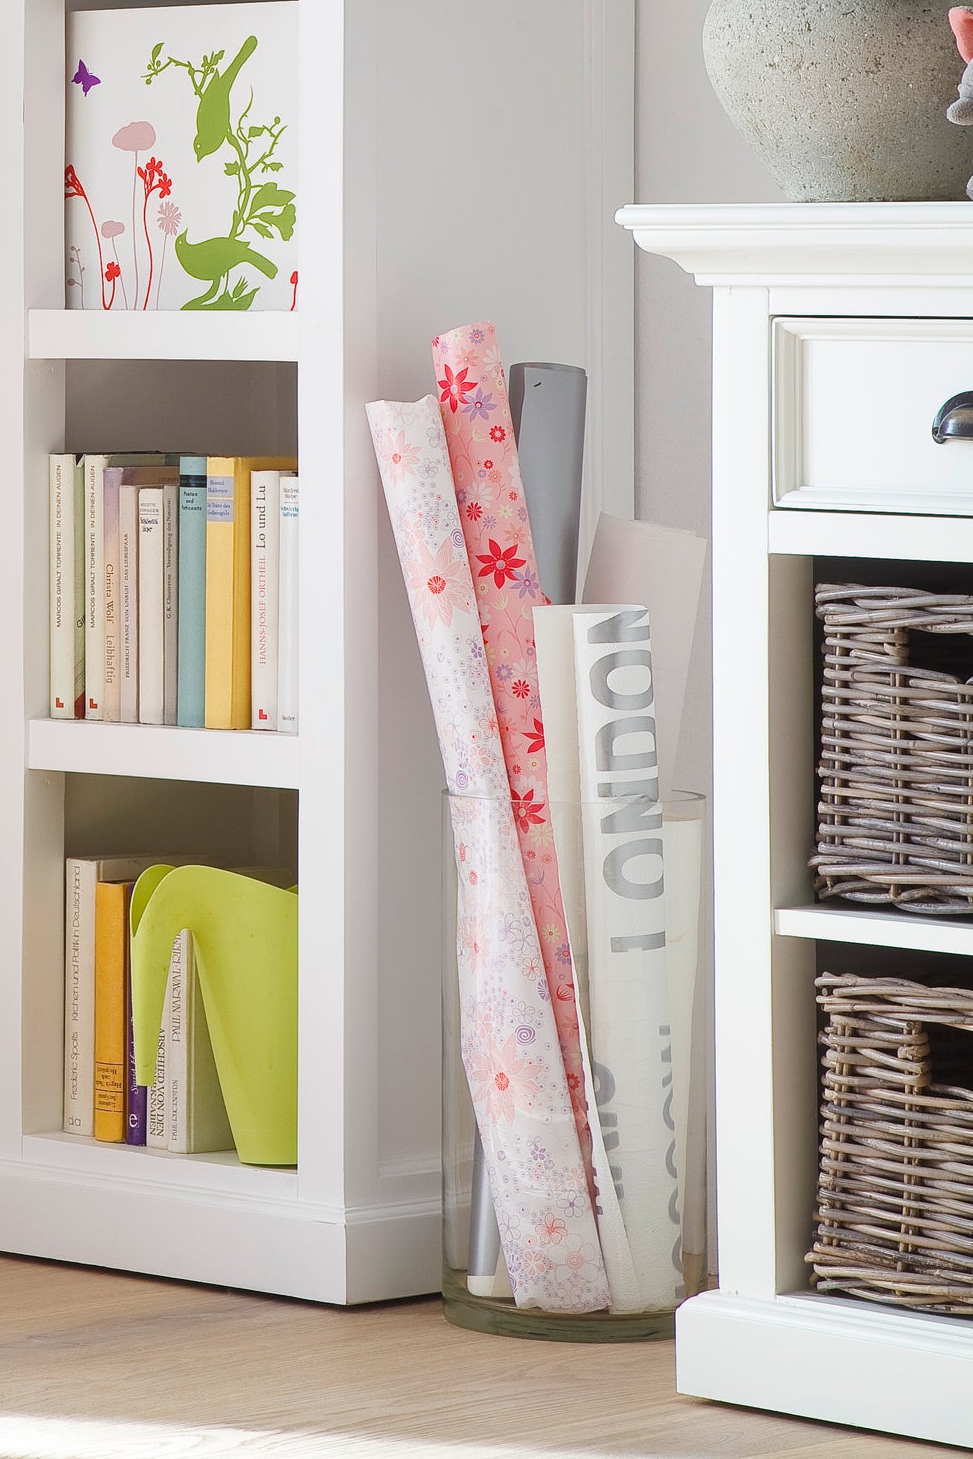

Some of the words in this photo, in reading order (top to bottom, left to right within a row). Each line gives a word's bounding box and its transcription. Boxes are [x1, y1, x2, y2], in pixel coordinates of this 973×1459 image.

[256, 485, 266, 501] Lu
[256, 506, 266, 529] und
[256, 533, 266, 549] Lo
[106, 563, 115, 598] Christa
[257, 555, 267, 599] ORTHEIL
[106, 600, 115, 624] Wolf
[258, 600, 267, 665] HANNS-JOSEF
[104, 634, 115, 684] Leibhaftig
[586, 609, 666, 953] LONDON
[72, 865, 81, 928] Deutschland
[72, 939, 80, 963] Politik
[71, 986, 79, 1021] Kirchen
[70, 1031, 79, 1060] Spotts
[69, 1061, 78, 1100] Frederic
[157, 1084, 165, 1112] VON
[157, 1113, 165, 1138] DEN
